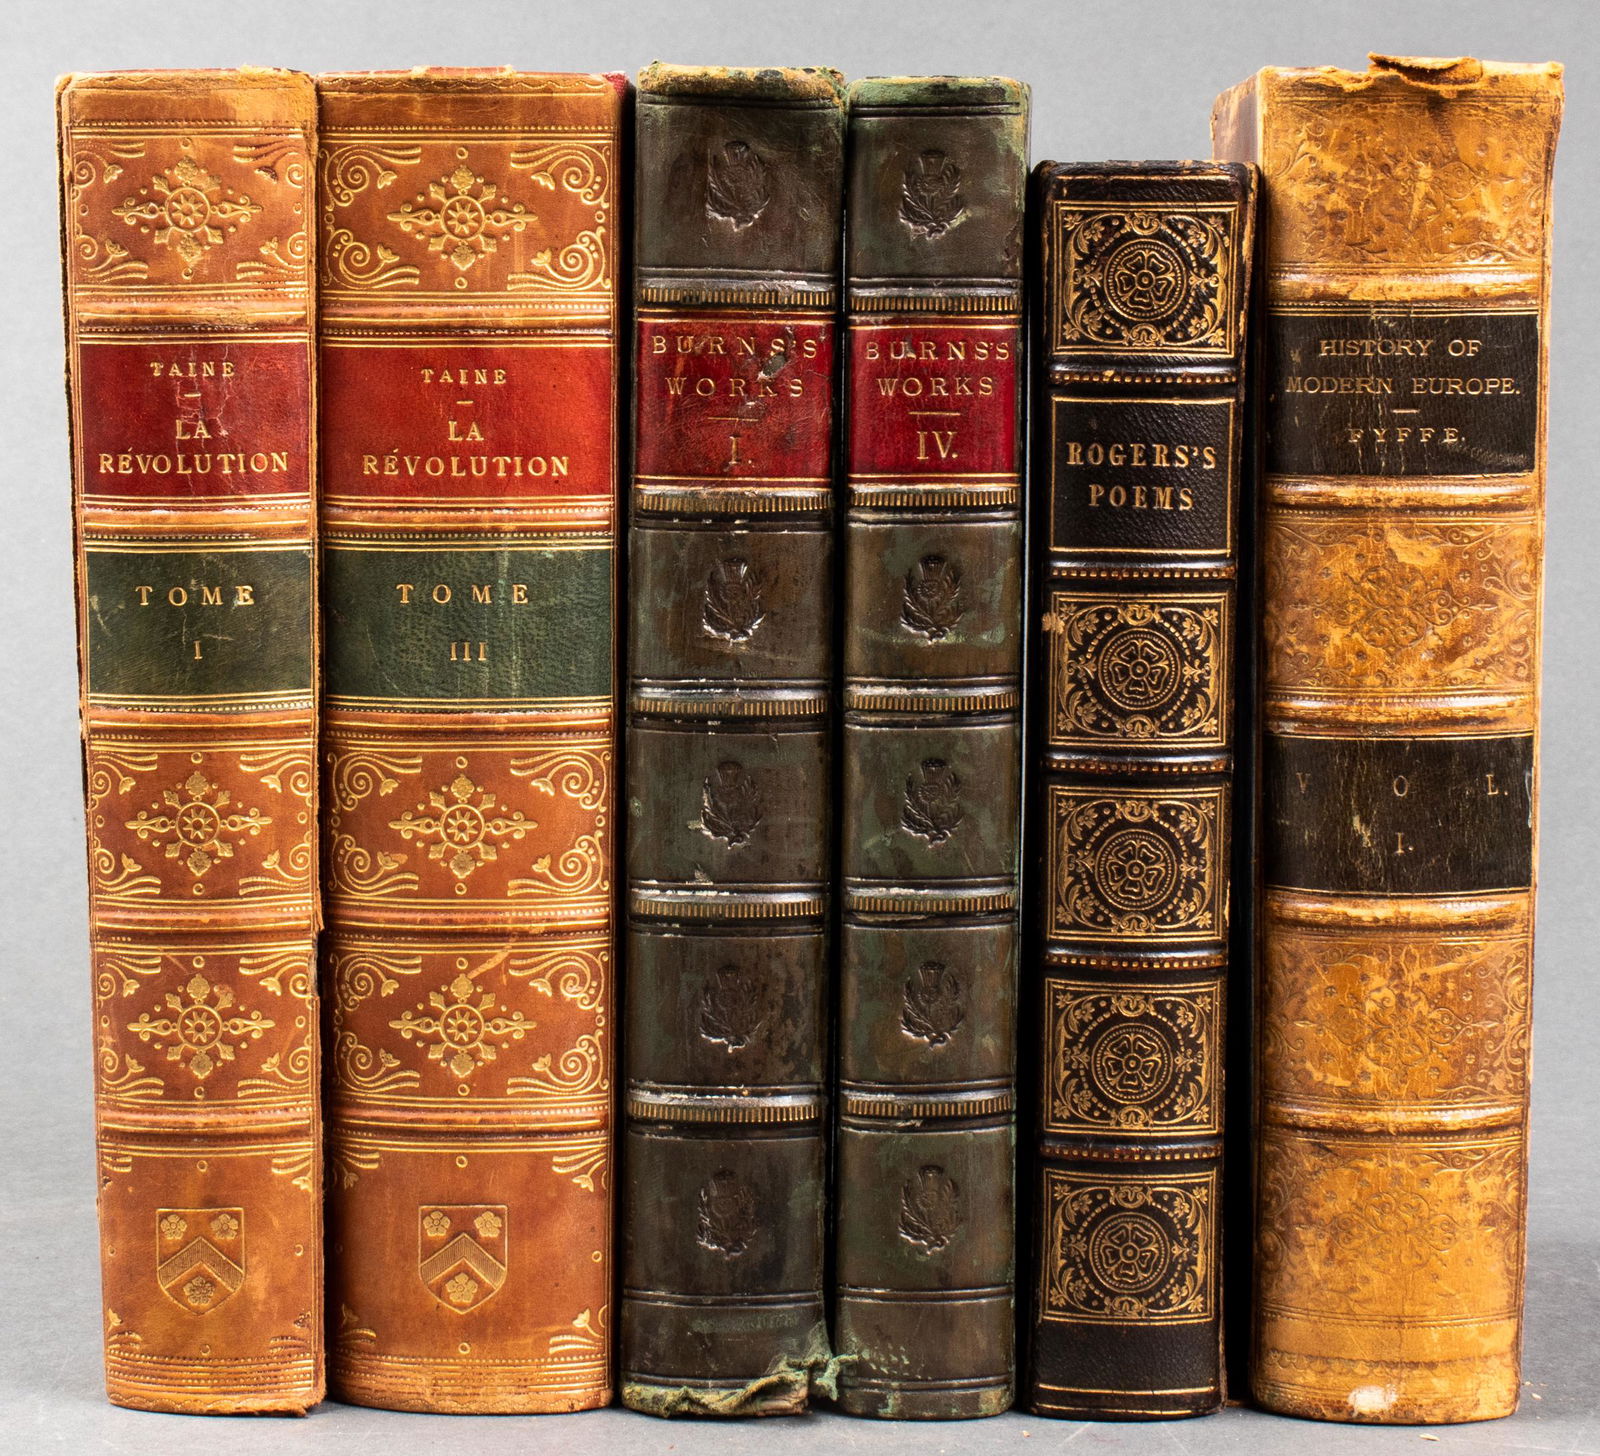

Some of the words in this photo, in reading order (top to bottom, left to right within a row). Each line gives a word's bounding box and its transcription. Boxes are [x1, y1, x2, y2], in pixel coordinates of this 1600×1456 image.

[865, 340, 1010, 361] BURNS'S
[1318, 338, 1435, 357] HISTORY
[1447, 338, 1483, 357] OF
[149, 361, 236, 378] TAINE
[420, 367, 507, 385] TAINE
[664, 376, 806, 398] WORKS
[875, 375, 994, 398] WORKS
[1285, 375, 1393, 395] MODERN
[1410, 376, 1521, 395] EUROPE.
[175, 418, 212, 441] LA
[447, 420, 485, 442] LA
[1348, 427, 1466, 443] FYFFE.
[727, 435, 754, 466] I.
[915, 430, 959, 461] IV.
[1066, 441, 1218, 470] ROGERS'S
[98, 446, 289, 475] RÉVOLUTION
[362, 447, 570, 477] RÉVOLUTION
[1088, 483, 1195, 511] POEMS
[135, 585, 255, 606] TOME
[395, 583, 529, 605] TOME
[193, 639, 203, 660] I
[449, 640, 489, 662] III
[1393, 831, 1415, 854] I.
